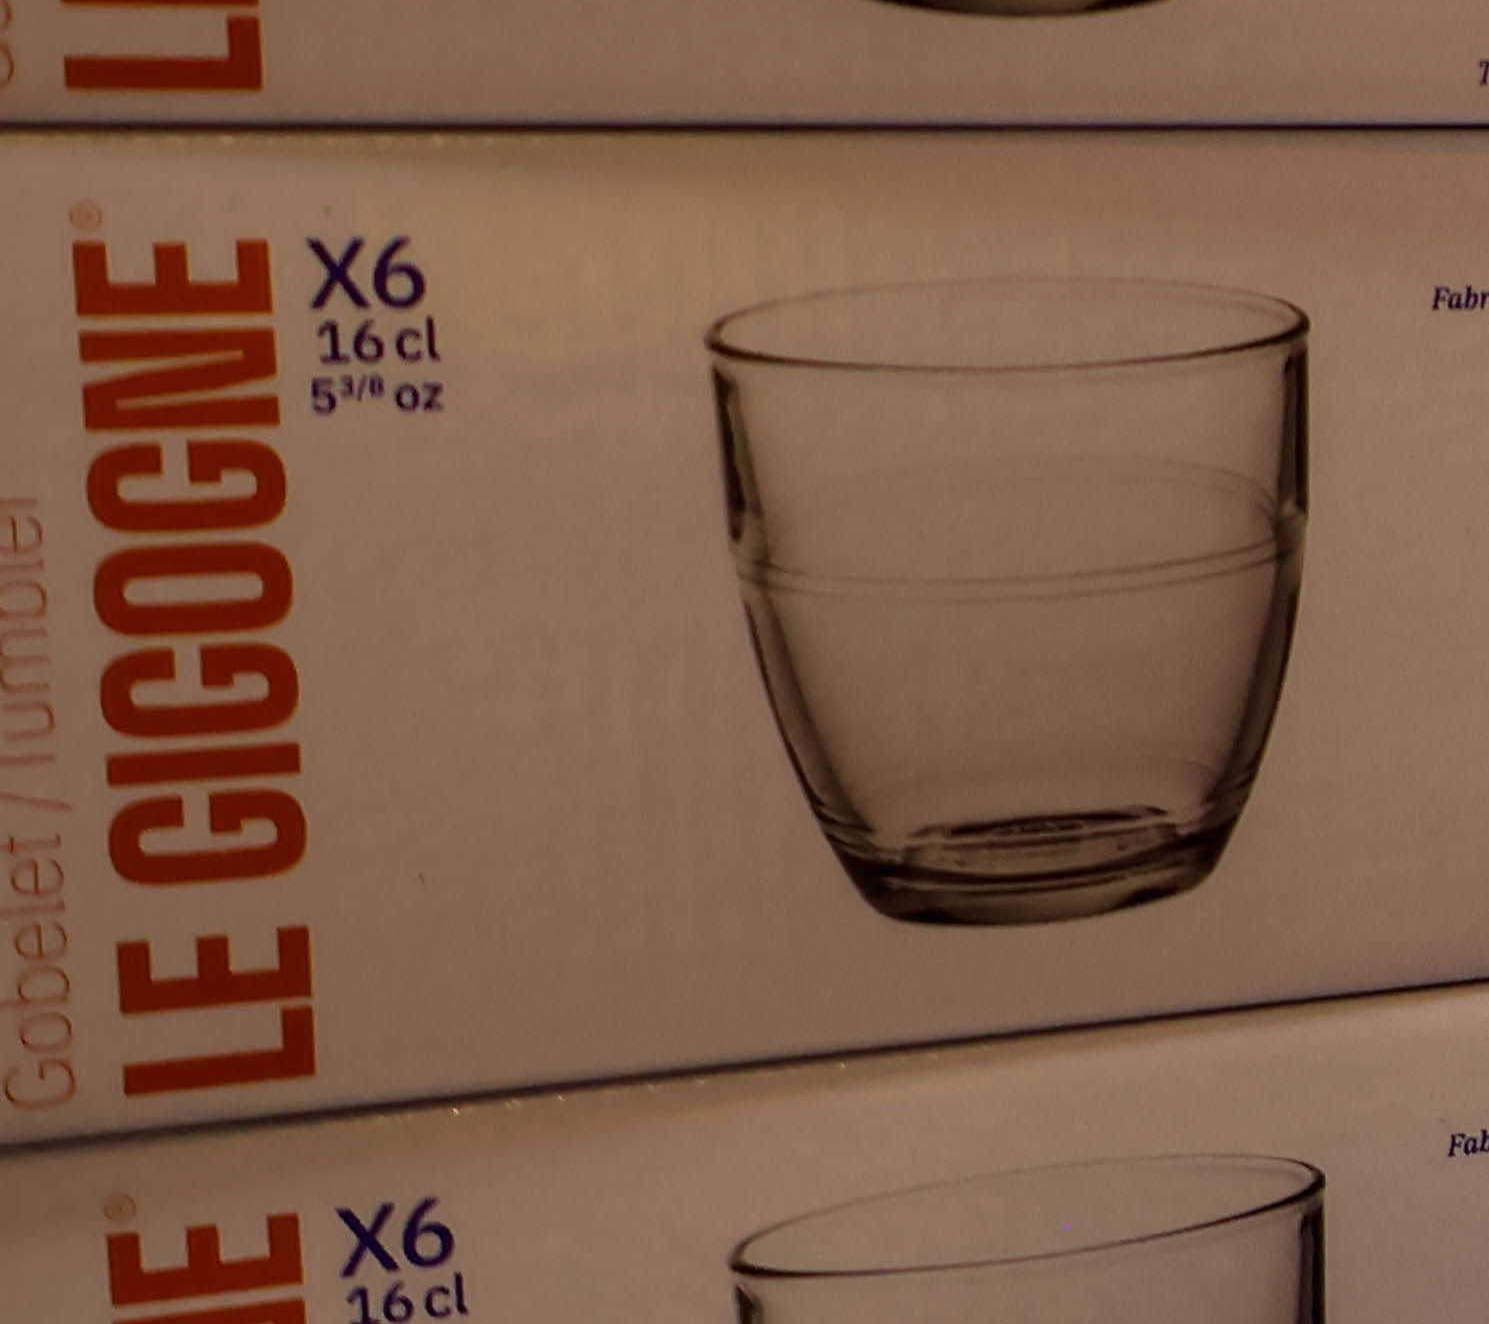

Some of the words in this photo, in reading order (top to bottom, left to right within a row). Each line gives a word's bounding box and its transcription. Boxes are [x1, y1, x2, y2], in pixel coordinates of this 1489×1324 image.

[306, 236, 426, 310] X6
[116, 926, 317, 1096] LE
[336, 1197, 455, 1278] X6
